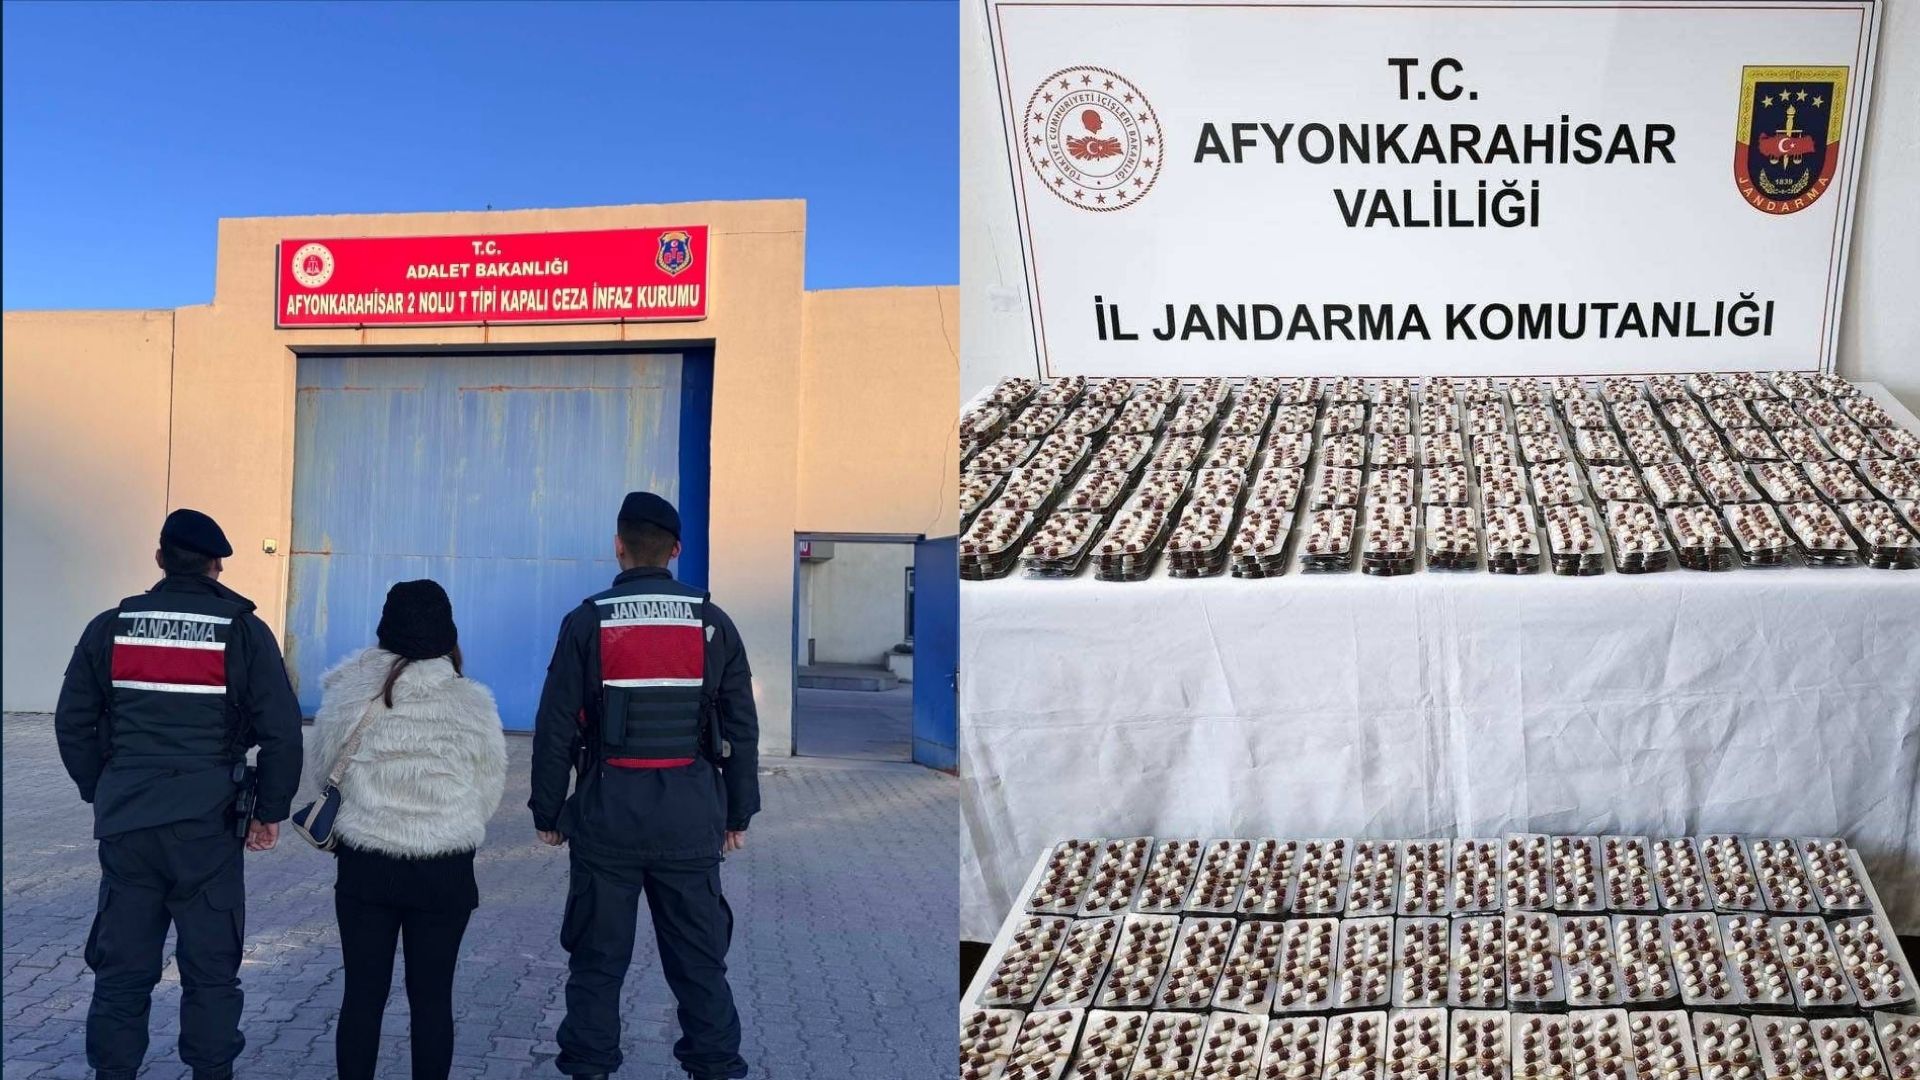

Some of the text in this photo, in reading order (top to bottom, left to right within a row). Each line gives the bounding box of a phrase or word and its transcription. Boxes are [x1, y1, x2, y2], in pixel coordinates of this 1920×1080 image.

[1387, 57, 1478, 101] T.C.
[1049, 92, 1138, 181] TÜRKİYE CUMHURİYETİ İÇİŞLERİ BAKANLIĞI
[1193, 114, 1676, 165] AFYONKARAHİSAR
[1333, 179, 1540, 228] VALİLİĞİ
[1739, 176, 1829, 212] JANDARMA
[471, 240, 502, 255] T.C.
[406, 257, 569, 279] ADALET BAKANLIĞI
[286, 281, 701, 315] AFYONKARAHİSAR 2 NOLU T TİPİ KAPALI CEZA İNFAZ KURUMU
[1094, 291, 1775, 341] İL JANDARMA KOMUTANLIĞI
[611, 600, 695, 620] JANDARMA
[127, 617, 216, 642] JANDARMA
